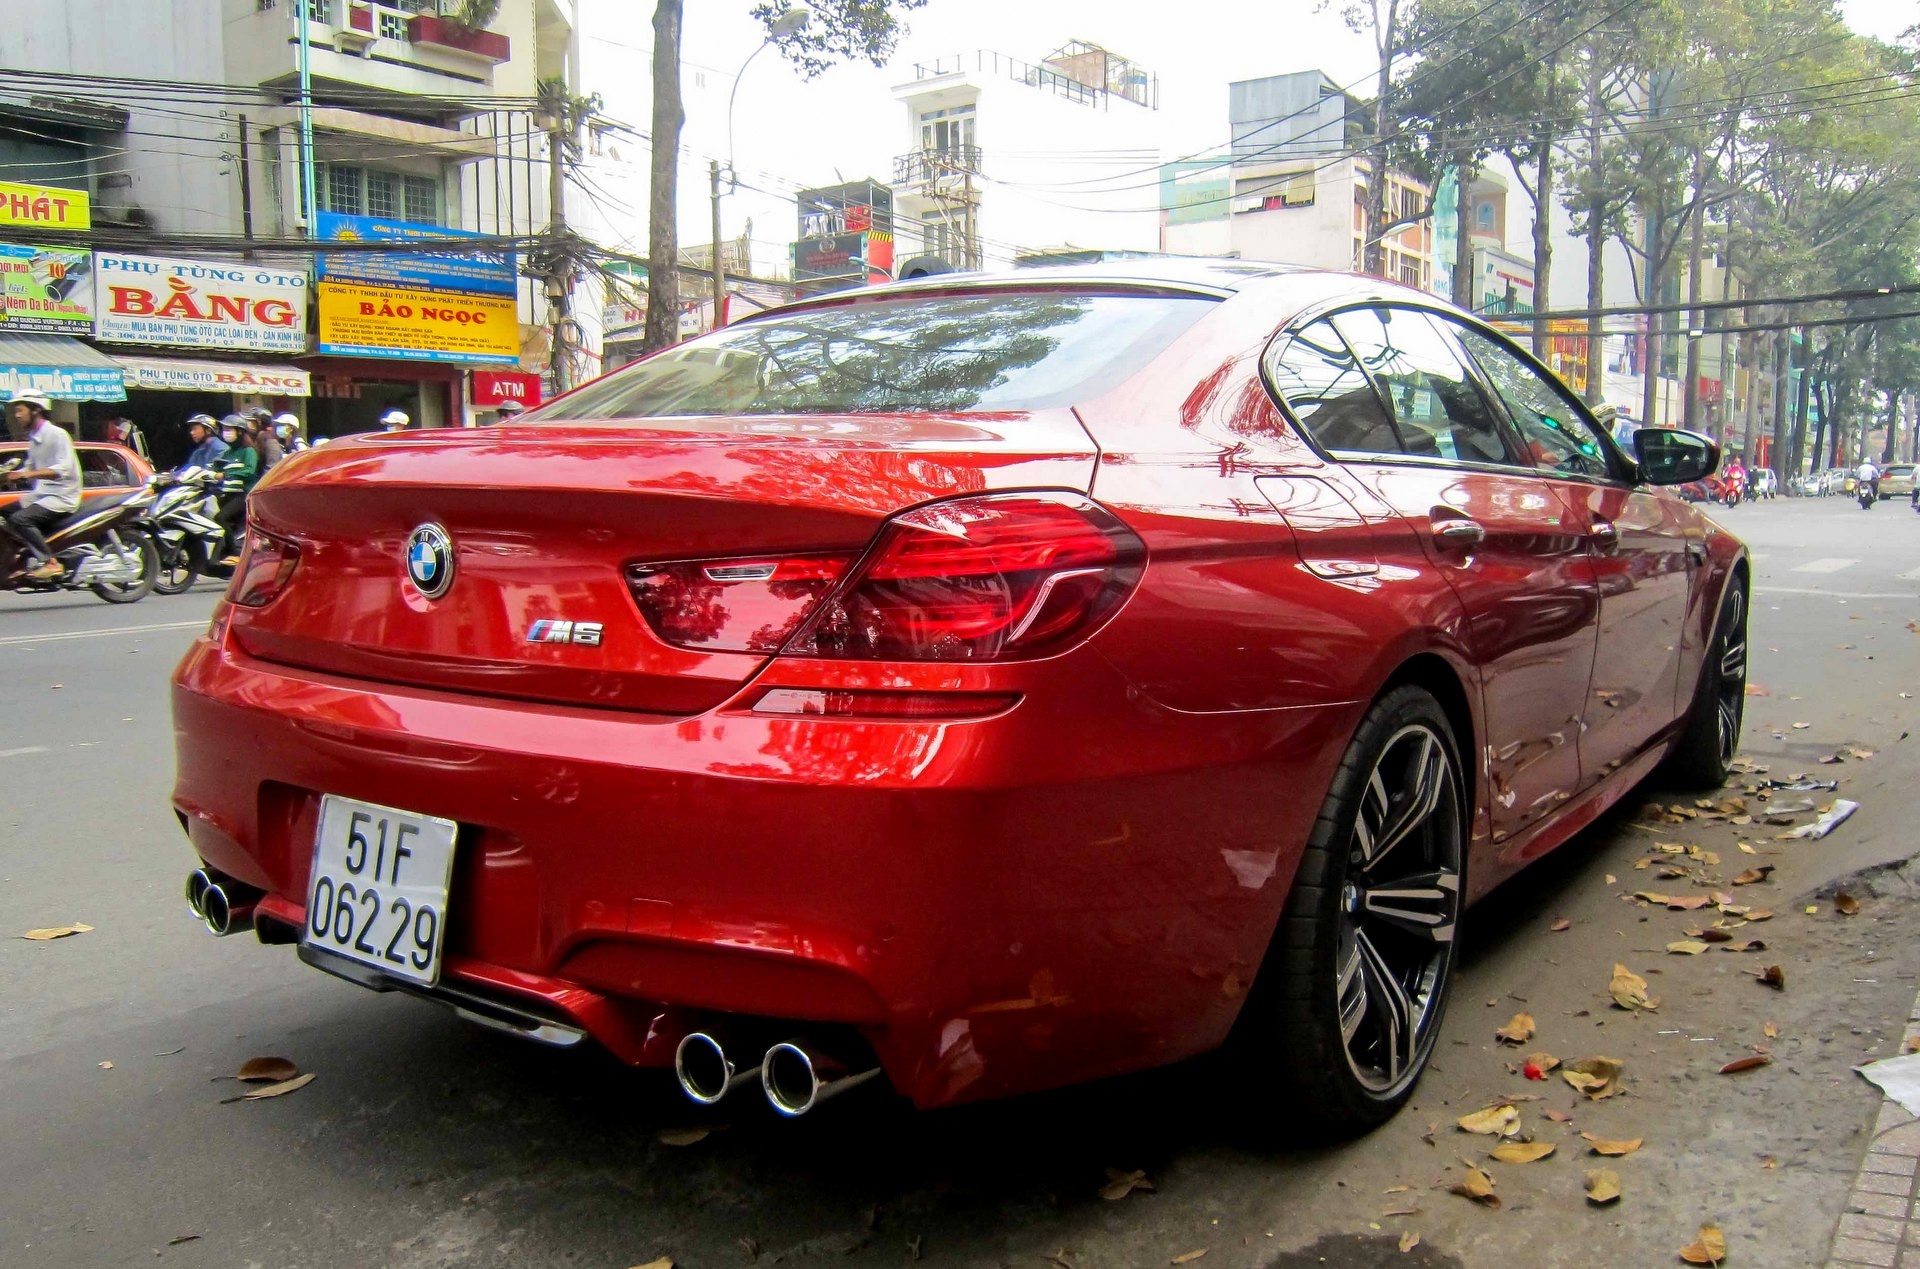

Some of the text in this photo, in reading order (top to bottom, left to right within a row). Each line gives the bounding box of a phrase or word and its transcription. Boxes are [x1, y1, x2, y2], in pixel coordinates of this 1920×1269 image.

[101, 258, 160, 275] PHỤ
[171, 265, 245, 282] TÙNG
[255, 271, 305, 287] ÔTÔ
[108, 277, 298, 326] BẰNG
[359, 299, 487, 326] BẢO NGỌC
[131, 321, 146, 332] MUA
[139, 369, 160, 379] PHỤ
[163, 369, 190, 380] TÙNG
[193, 371, 212, 382] ÔTÔ
[214, 370, 303, 388] BẰNG
[492, 381, 526, 397] ATM
[346, 811, 420, 887] 51F
[312, 875, 437, 971] 062.29
